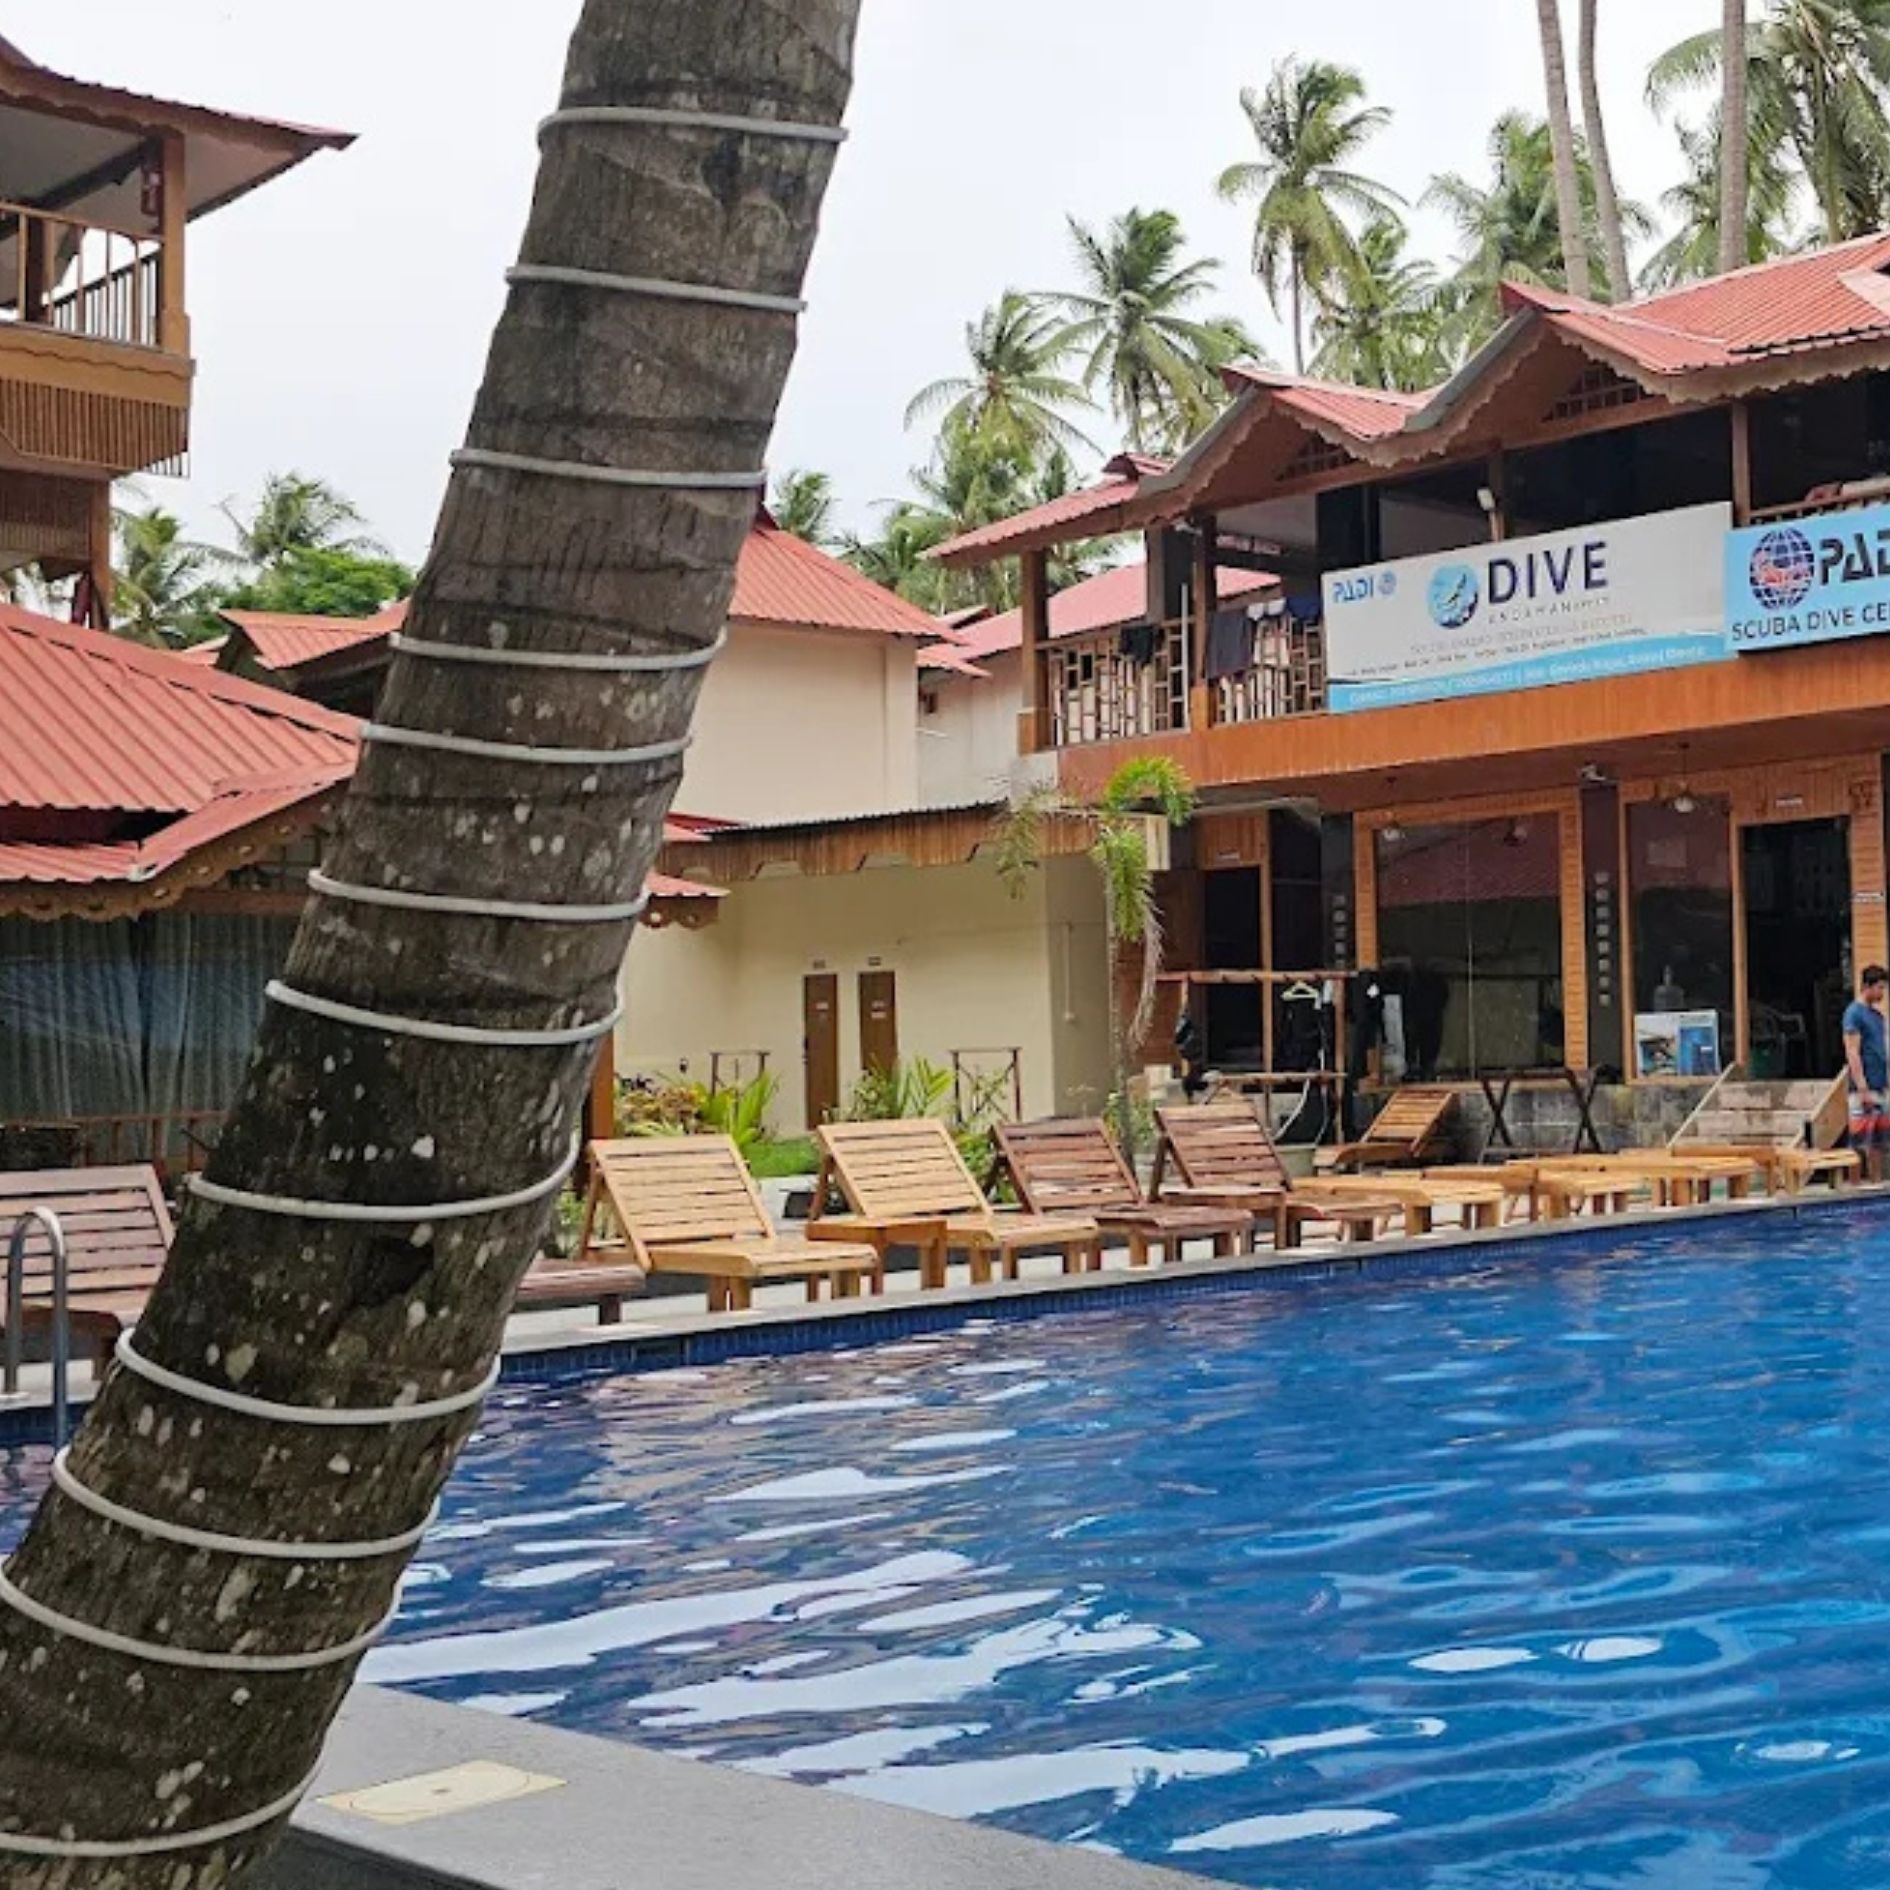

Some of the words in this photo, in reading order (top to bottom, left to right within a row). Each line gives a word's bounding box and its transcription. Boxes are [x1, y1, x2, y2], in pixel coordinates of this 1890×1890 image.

[1333, 576, 1374, 603] PADI
[1488, 541, 1609, 604] DIVE
[1732, 616, 1801, 641] SCUBA
[1807, 607, 1856, 631] DIVE
